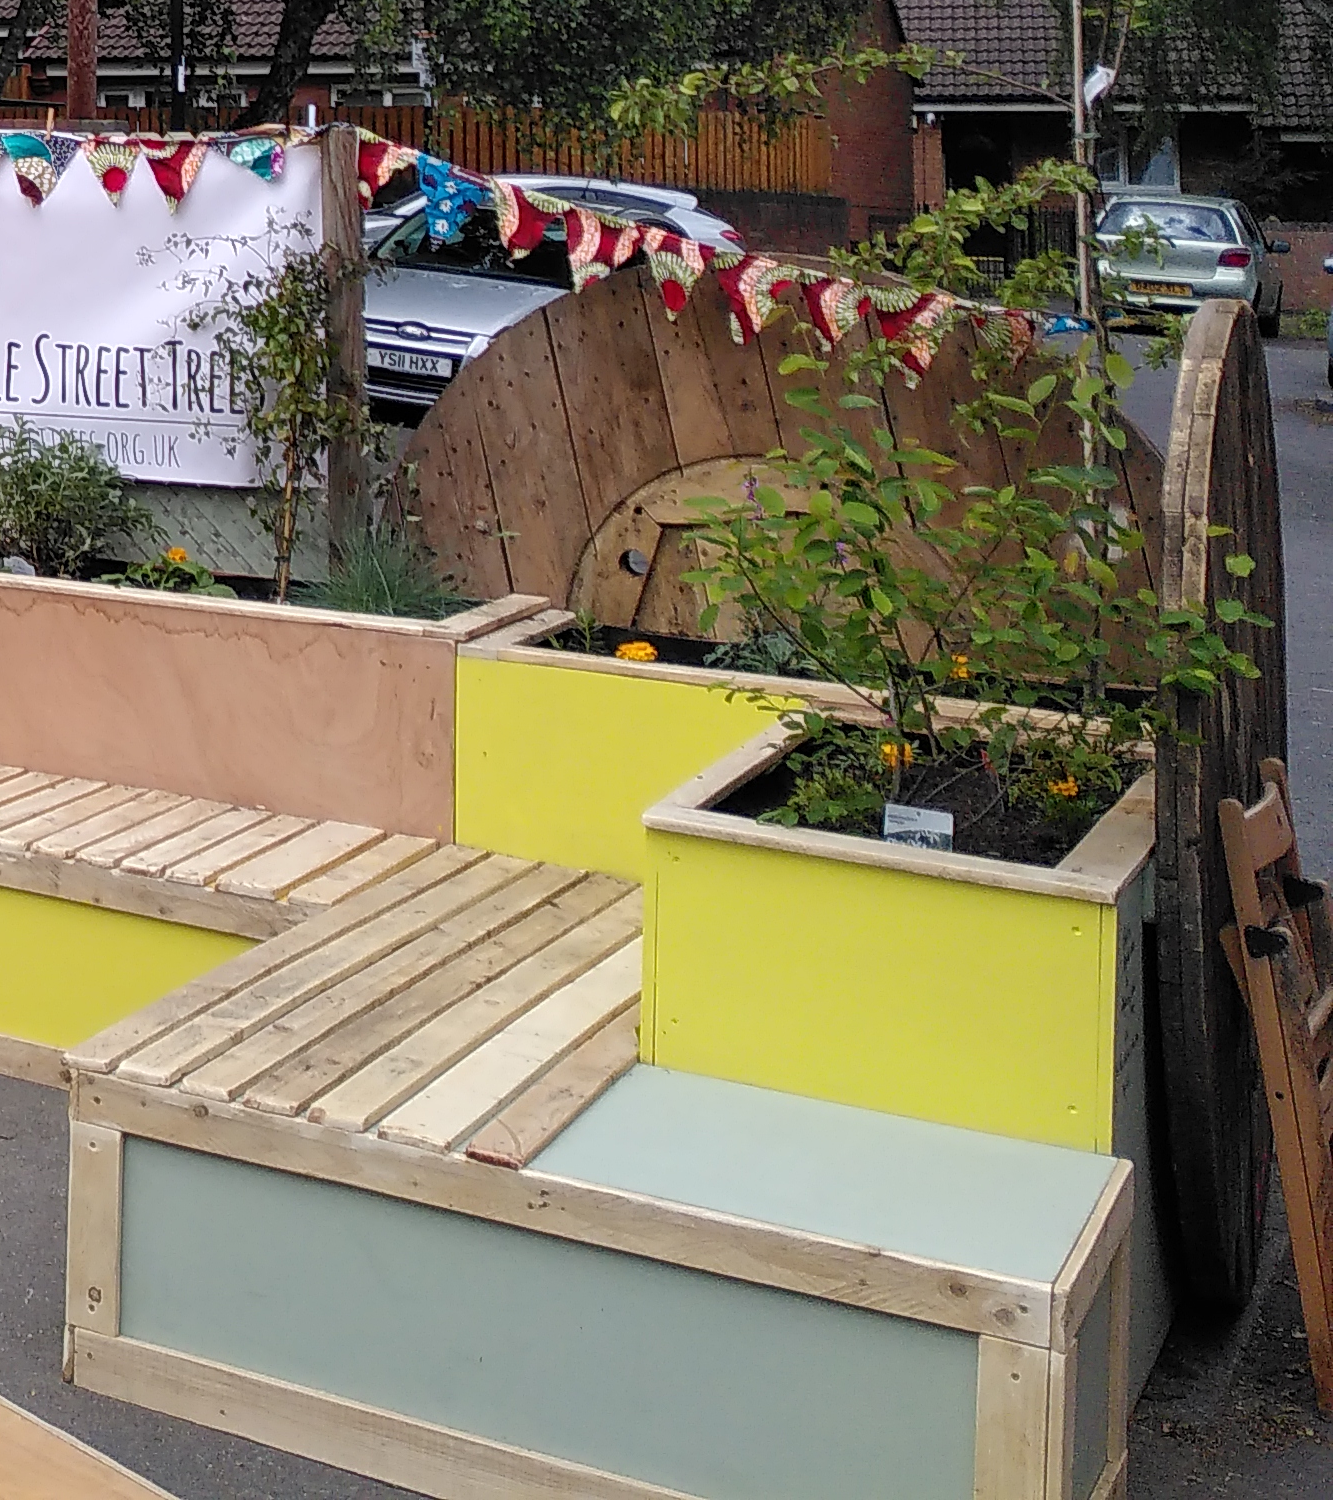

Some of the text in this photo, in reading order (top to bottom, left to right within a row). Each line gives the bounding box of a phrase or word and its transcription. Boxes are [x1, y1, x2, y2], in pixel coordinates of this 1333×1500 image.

[31, 333, 153, 409] STREET
[378, 350, 440, 373] YS11 HXX
